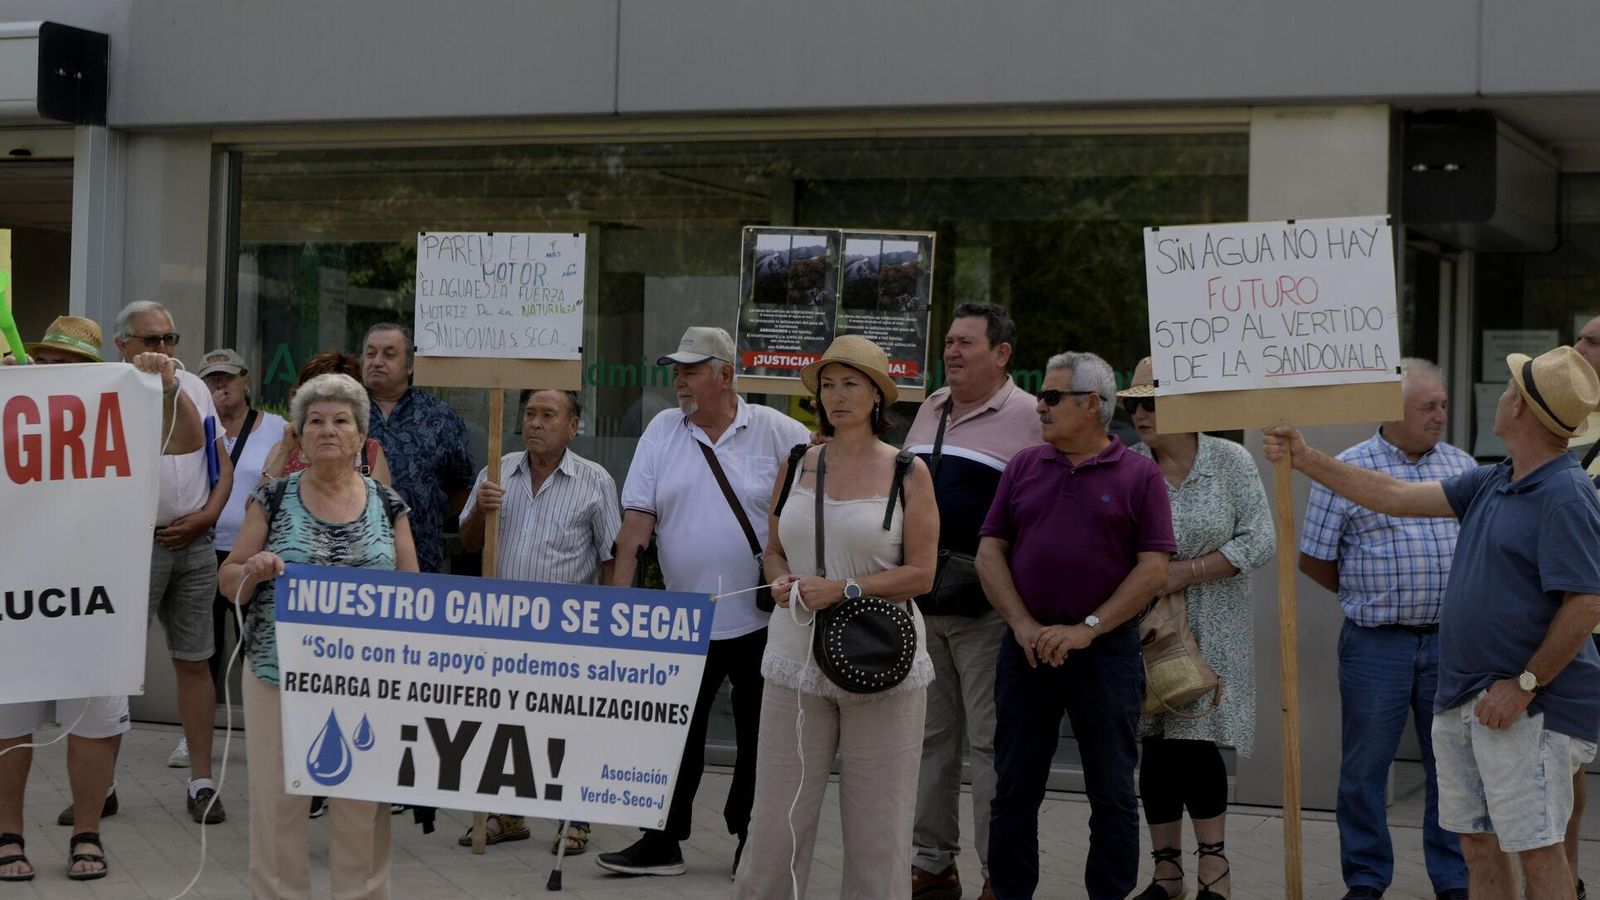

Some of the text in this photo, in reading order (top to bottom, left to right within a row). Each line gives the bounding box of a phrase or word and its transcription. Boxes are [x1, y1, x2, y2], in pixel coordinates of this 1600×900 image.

[508, 234, 536, 261] EL
[1201, 232, 1275, 269] AGUA
[1282, 227, 1318, 260] NO
[1326, 227, 1379, 260] HAY
[438, 278, 473, 298] AGUA
[491, 283, 508, 299] LA
[518, 286, 565, 302] FUERZA
[1207, 274, 1319, 312] FUTURO
[420, 303, 468, 320] MOTRIZ
[424, 322, 506, 350] SANDOVALA
[1155, 315, 1230, 348] STOP
[1241, 313, 1276, 342] AL
[753, 354, 815, 367] ¡JUSTICIA!
[1172, 342, 1388, 383] DE LA SANDOVALA
[2, 391, 132, 485] GRA
[0, 585, 116, 621] UCIA
[287, 578, 701, 642] ¡NUESTRO CAMPO SE SECA!
[361, 645, 395, 664] con
[402, 644, 421, 666] tu
[428, 650, 485, 675] apoyo
[492, 653, 580, 679] podemos
[285, 671, 690, 726] RECARGA DE ACUIFERO Y CANALIZACIONES
[397, 716, 566, 802] ¡YA!
[601, 764, 668, 786] Asociación
[580, 786, 665, 810] Verde-Seco-J
